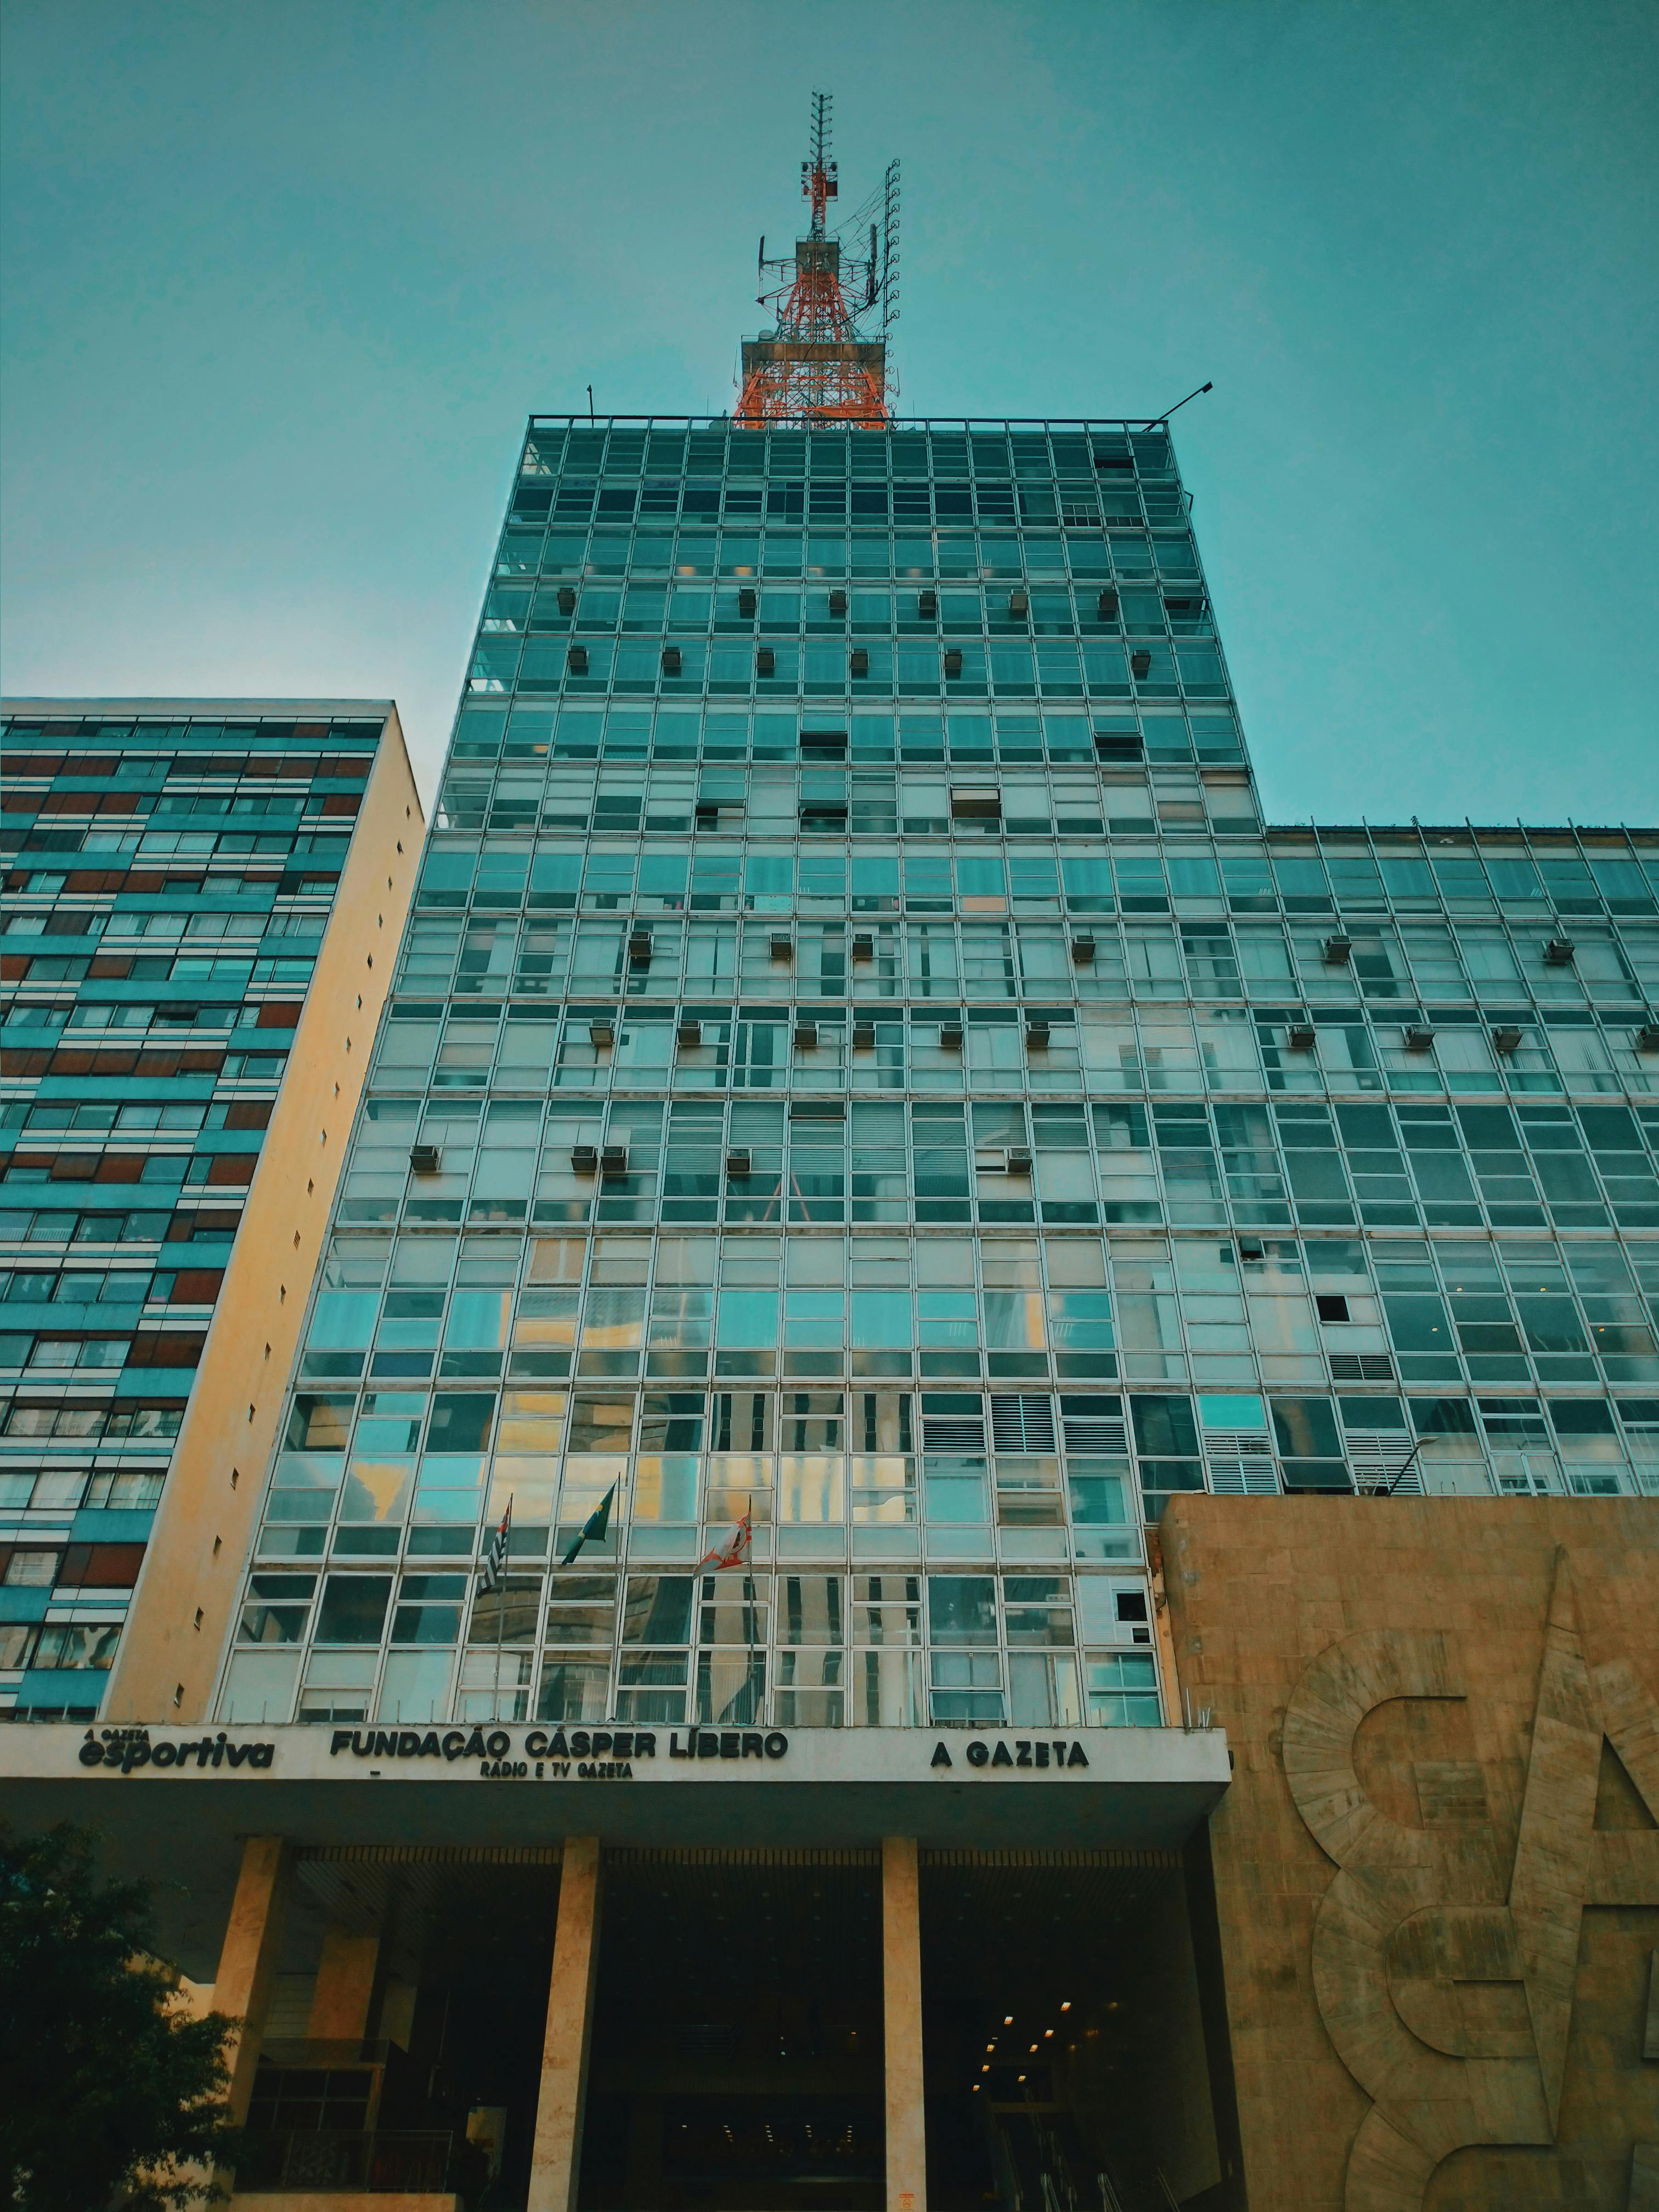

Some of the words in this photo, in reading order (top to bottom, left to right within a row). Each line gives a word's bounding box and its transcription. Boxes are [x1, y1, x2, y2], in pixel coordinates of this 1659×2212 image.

[83, 1729, 94, 1741] A
[101, 1729, 149, 1742] GAZETA
[330, 1726, 511, 1760] FUNDAÇÃO
[525, 1726, 656, 1758] CÁSPER
[669, 1727, 788, 1758] LÍBERO
[79, 1733, 275, 1774] esportiva
[930, 1741, 952, 1767] A
[966, 1741, 1090, 1767] GAZETA
[480, 1758, 528, 1777] RÁDIO
[535, 1762, 544, 1776] E
[552, 1762, 571, 1778] TV
[578, 1762, 633, 1778] GAZETA
